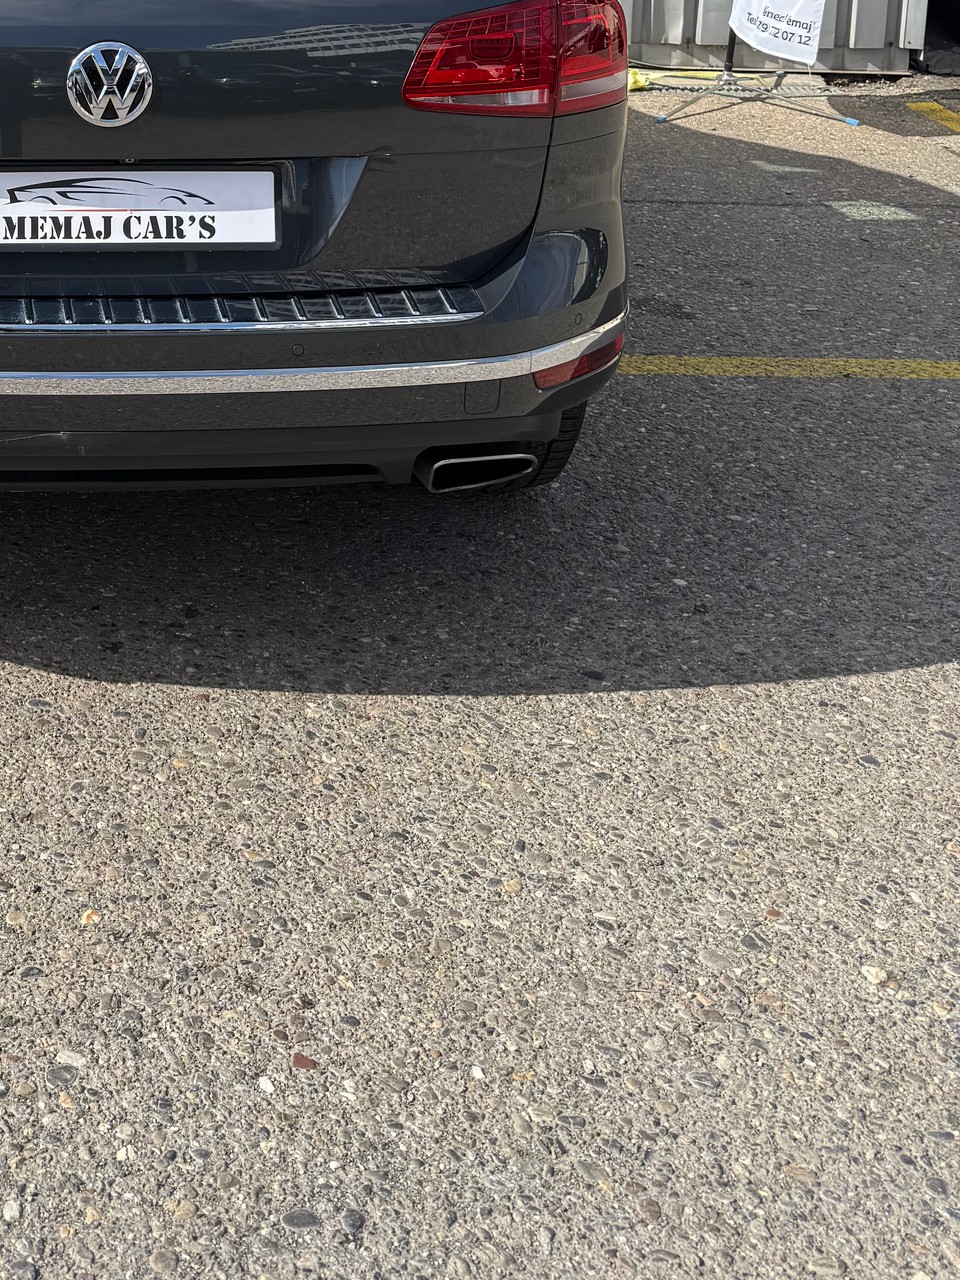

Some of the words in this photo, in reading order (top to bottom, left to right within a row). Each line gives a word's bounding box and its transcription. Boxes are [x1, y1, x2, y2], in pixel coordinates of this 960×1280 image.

[782, 31, 795, 42] 07
[797, 35, 811, 46] 12
[2, 216, 113, 240] MEMAJ
[123, 215, 216, 240] CAR'S
